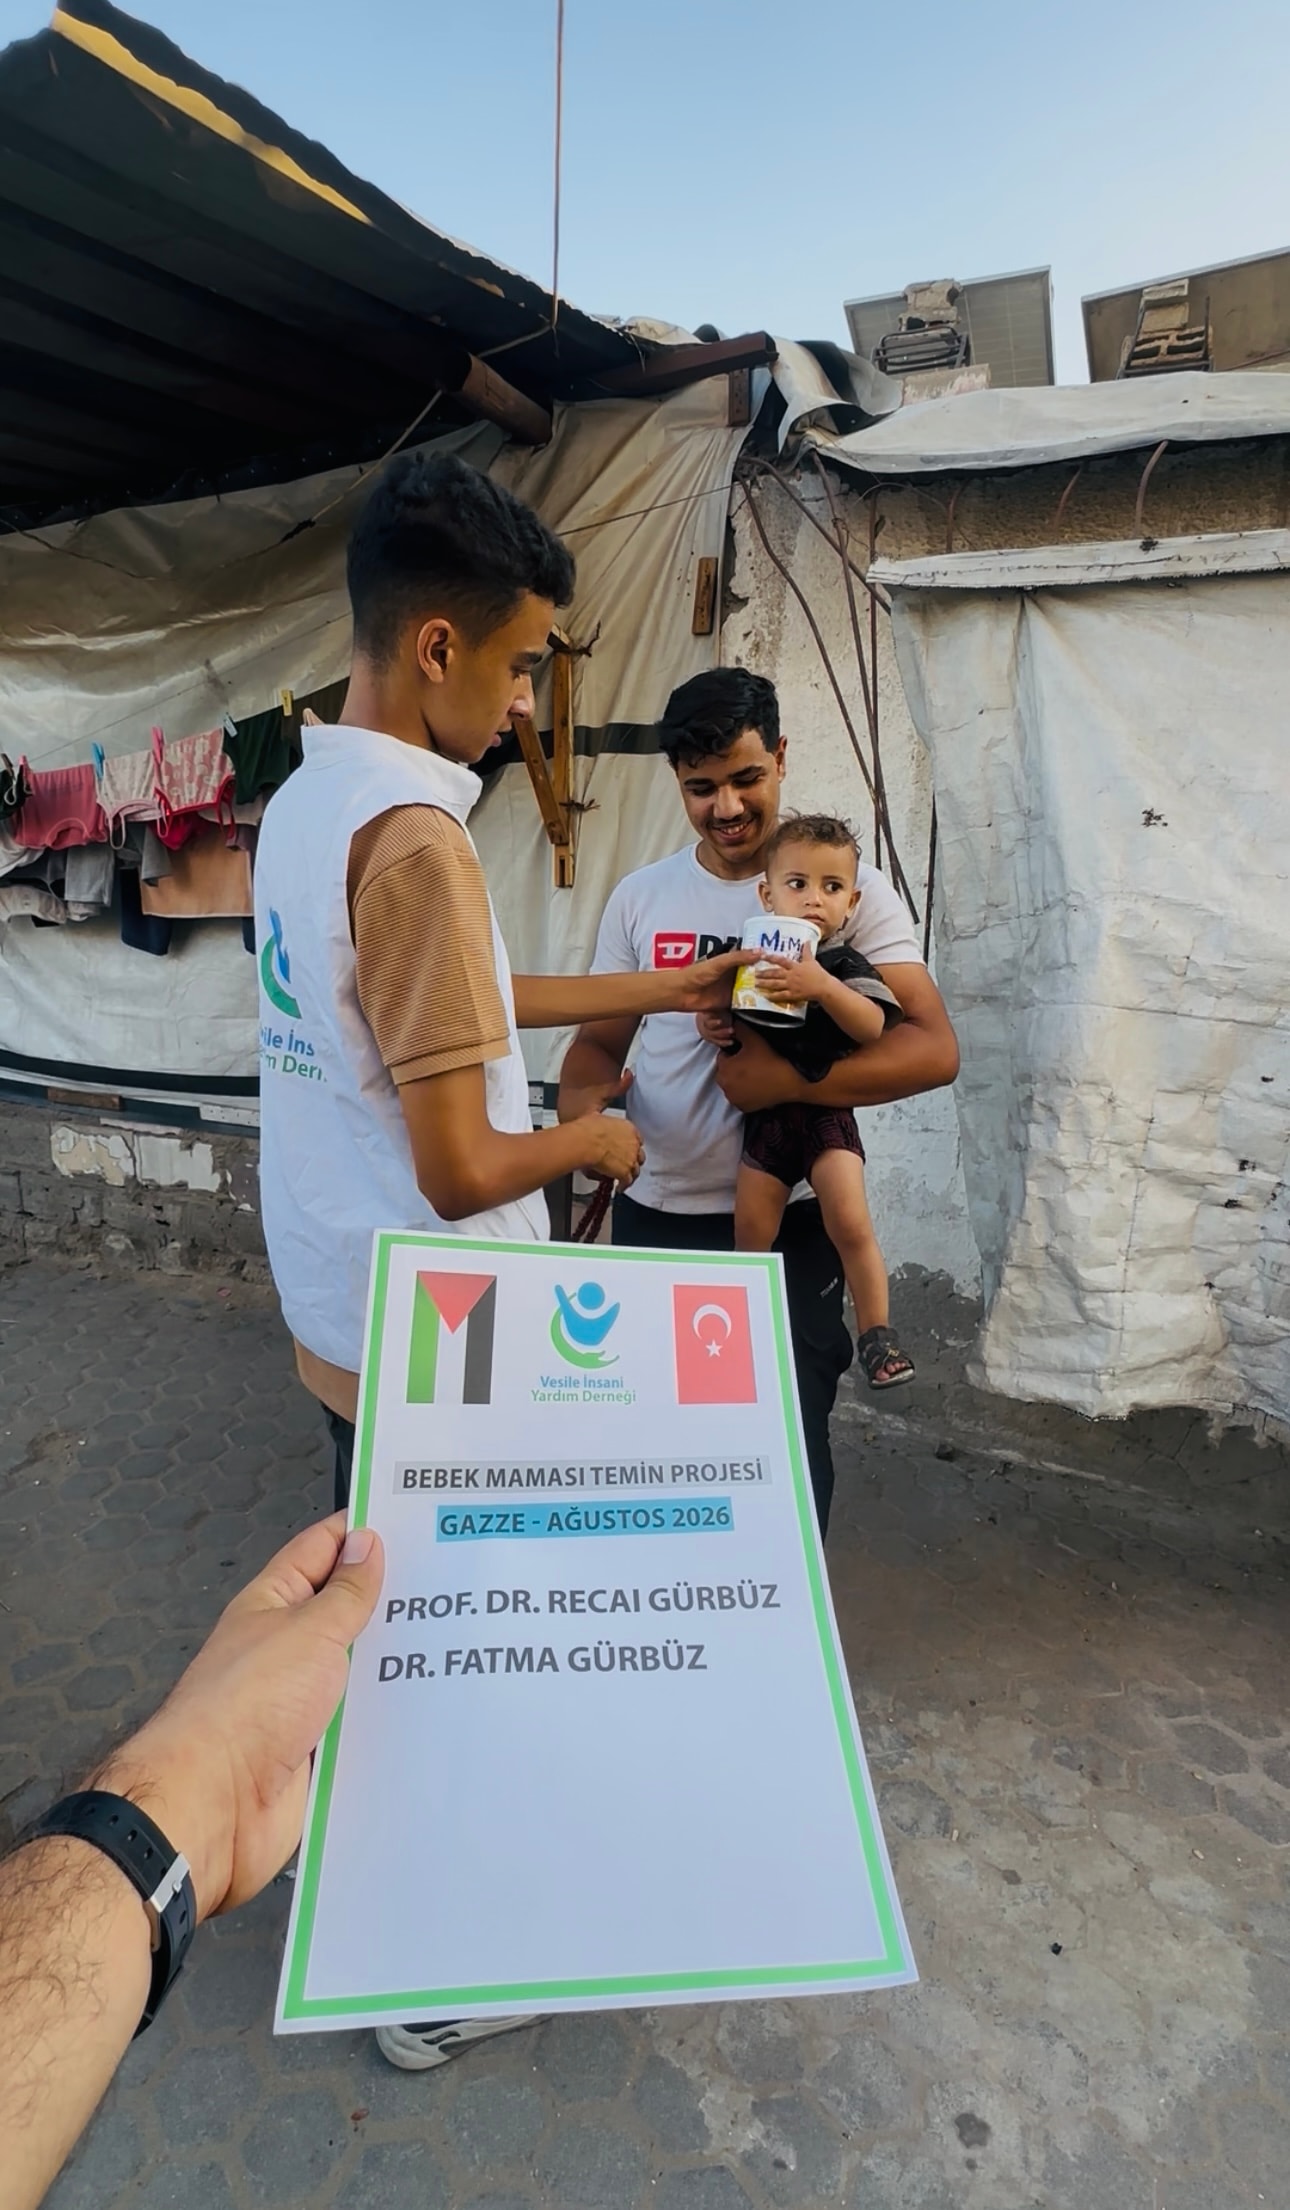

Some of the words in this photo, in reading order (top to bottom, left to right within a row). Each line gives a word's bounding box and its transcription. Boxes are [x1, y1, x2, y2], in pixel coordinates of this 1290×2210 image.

[540, 1375, 580, 1388] Vesile
[583, 1374, 624, 1388] İnsani
[531, 1389, 579, 1402] Yardım
[583, 1389, 636, 1405] Derneği
[402, 1468, 480, 1489] BEBEK
[486, 1467, 585, 1488] MAMASI
[590, 1461, 664, 1485] TEMİN
[671, 1458, 763, 1483] PROJESİ
[440, 1513, 525, 1536] GAZZE
[547, 1506, 665, 1532] AĞUSTOS
[672, 1506, 730, 1527] 2026
[385, 1592, 478, 1623] PROF.
[486, 1589, 540, 1614] DR.
[548, 1589, 640, 1613] RECAI
[648, 1579, 781, 1612] GÜRBÜZ
[378, 1653, 435, 1682] DR.
[444, 1647, 560, 1676] FATMA
[567, 1639, 708, 1672] GÜRBÜZ
